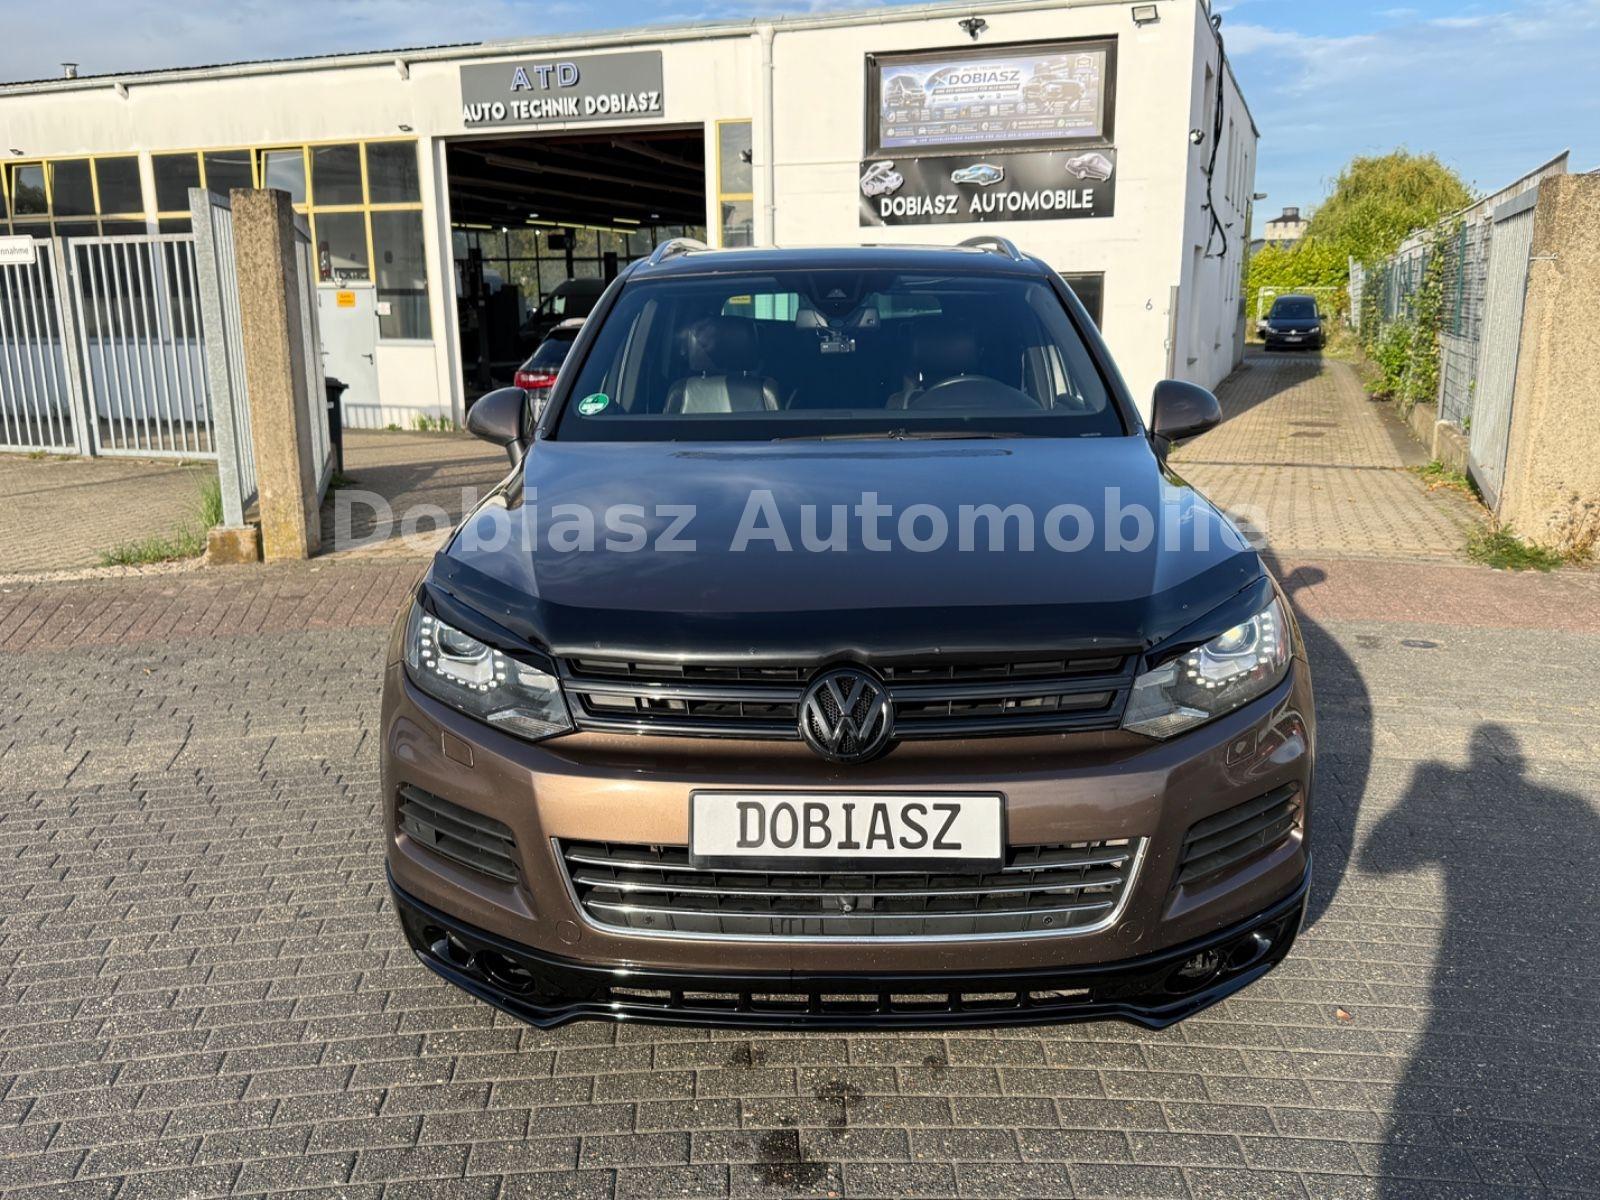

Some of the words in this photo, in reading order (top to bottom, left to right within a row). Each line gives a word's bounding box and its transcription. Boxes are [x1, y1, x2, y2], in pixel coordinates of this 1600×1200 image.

[510, 62, 579, 91] ATD
[949, 70, 1021, 85] DOBIASZ
[463, 101, 506, 122] AUTO
[511, 97, 579, 119] TECHNIK
[585, 91, 661, 115] DOBIASZ
[881, 195, 960, 217] DOBIASZ
[969, 188, 1094, 214] AUTOMOBILE
[1145, 297, 1153, 311] 6
[736, 801, 962, 850] DOBIASZ
